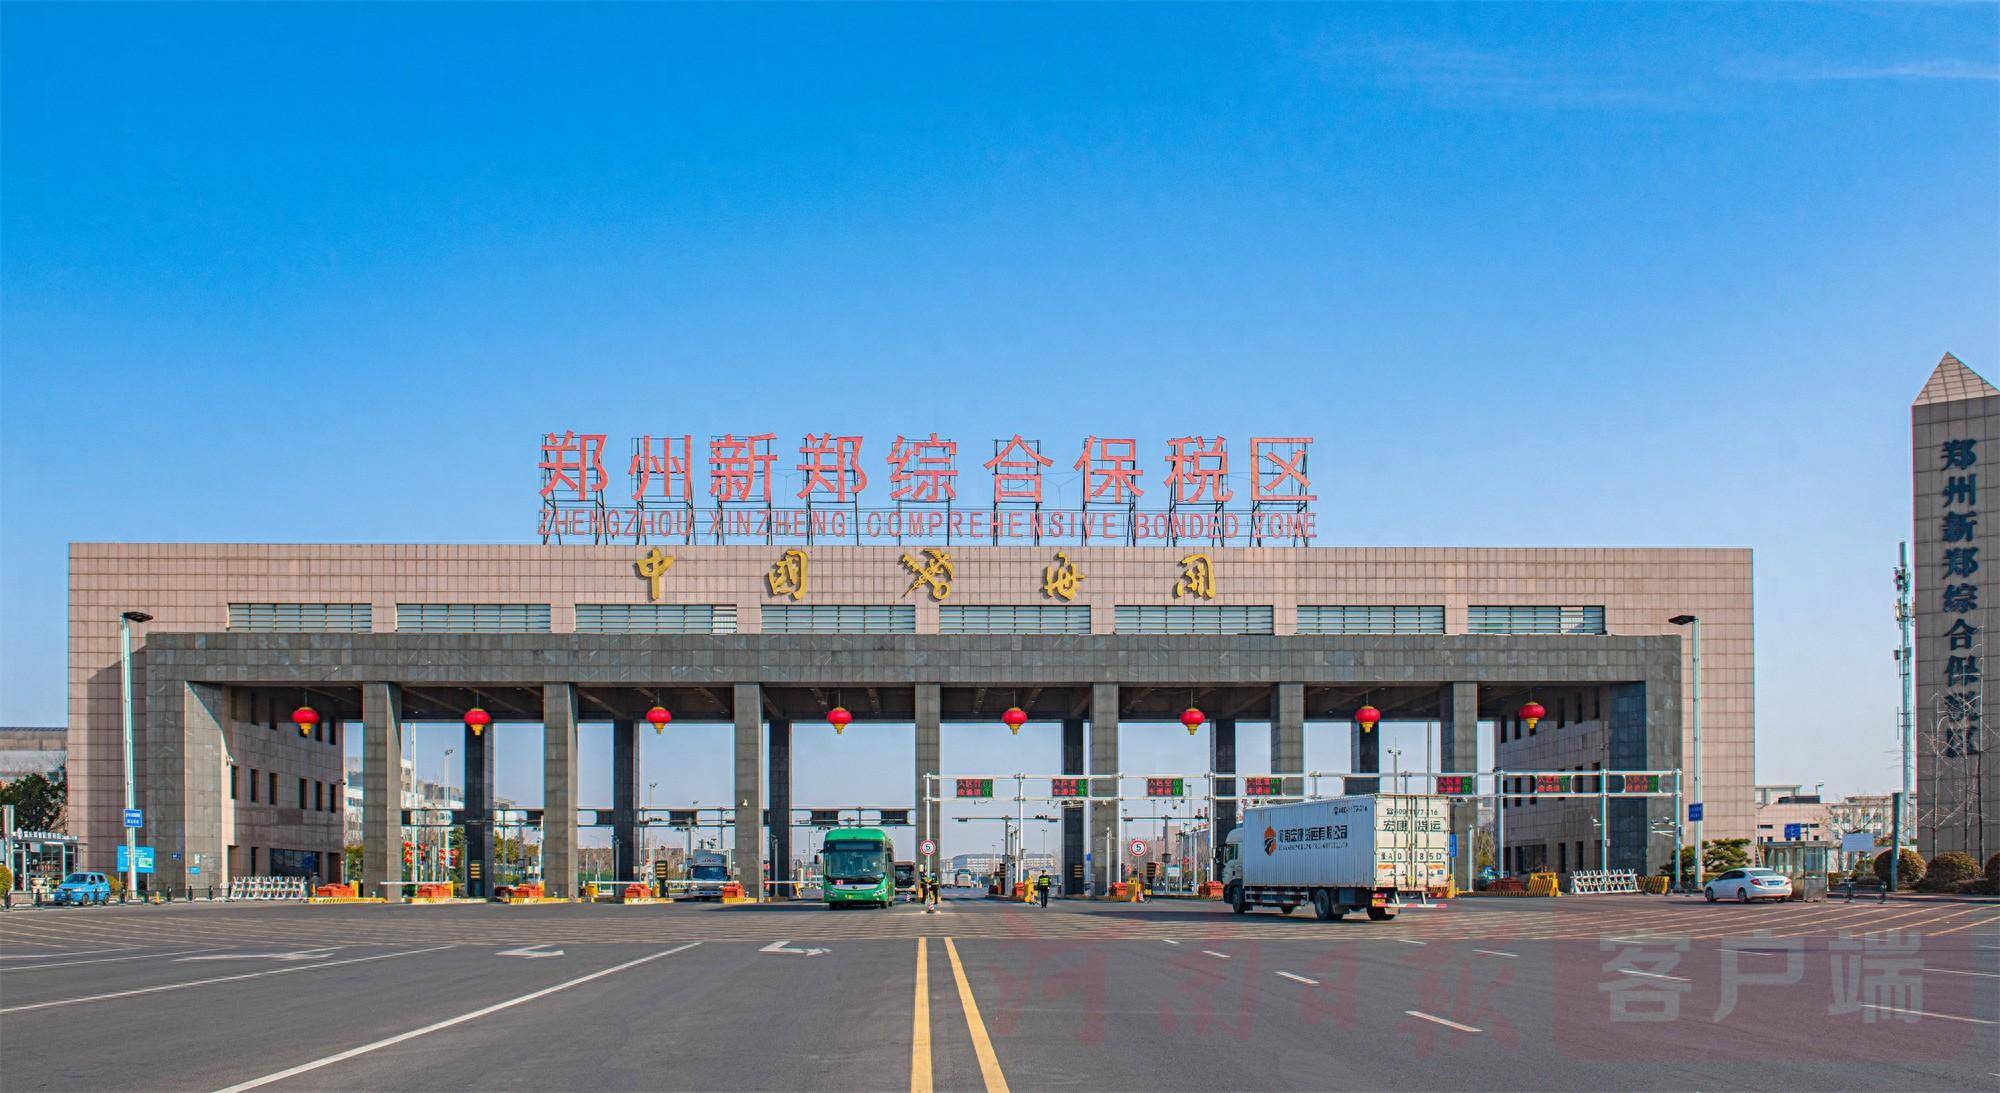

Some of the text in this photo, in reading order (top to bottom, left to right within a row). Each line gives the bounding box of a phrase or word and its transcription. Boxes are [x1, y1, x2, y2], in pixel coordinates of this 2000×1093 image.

[538, 432, 1316, 503] 郑州新郑综合保税区
[538, 508, 1315, 539] ZHENGZHOU XINZHENG COMPREHENSIVE BONDED ZONE
[924, 844, 932, 852] 5
[1134, 844, 1143, 852] 5
